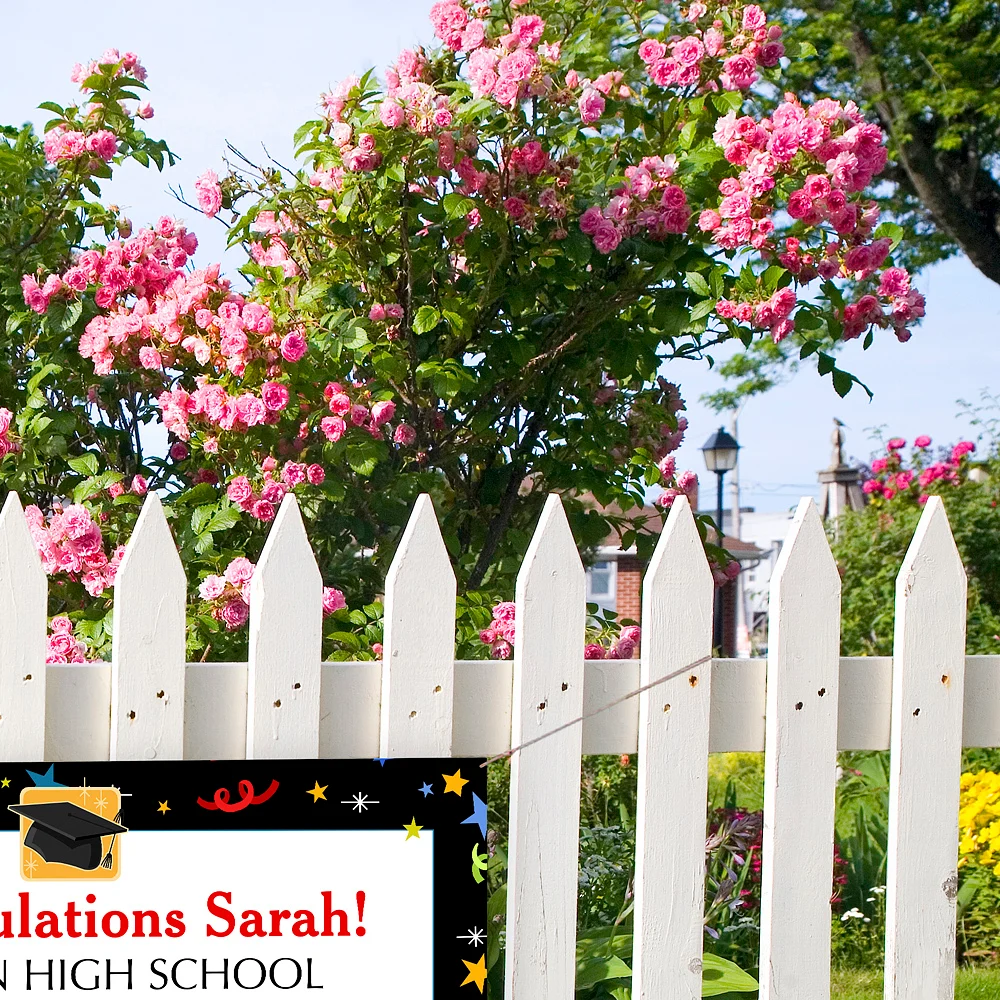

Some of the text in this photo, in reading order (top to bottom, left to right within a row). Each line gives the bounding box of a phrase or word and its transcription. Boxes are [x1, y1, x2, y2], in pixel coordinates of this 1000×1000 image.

[206, 890, 367, 938] Sarah!
[26, 958, 133, 991] HIGH
[149, 957, 324, 991] SCHOOL
